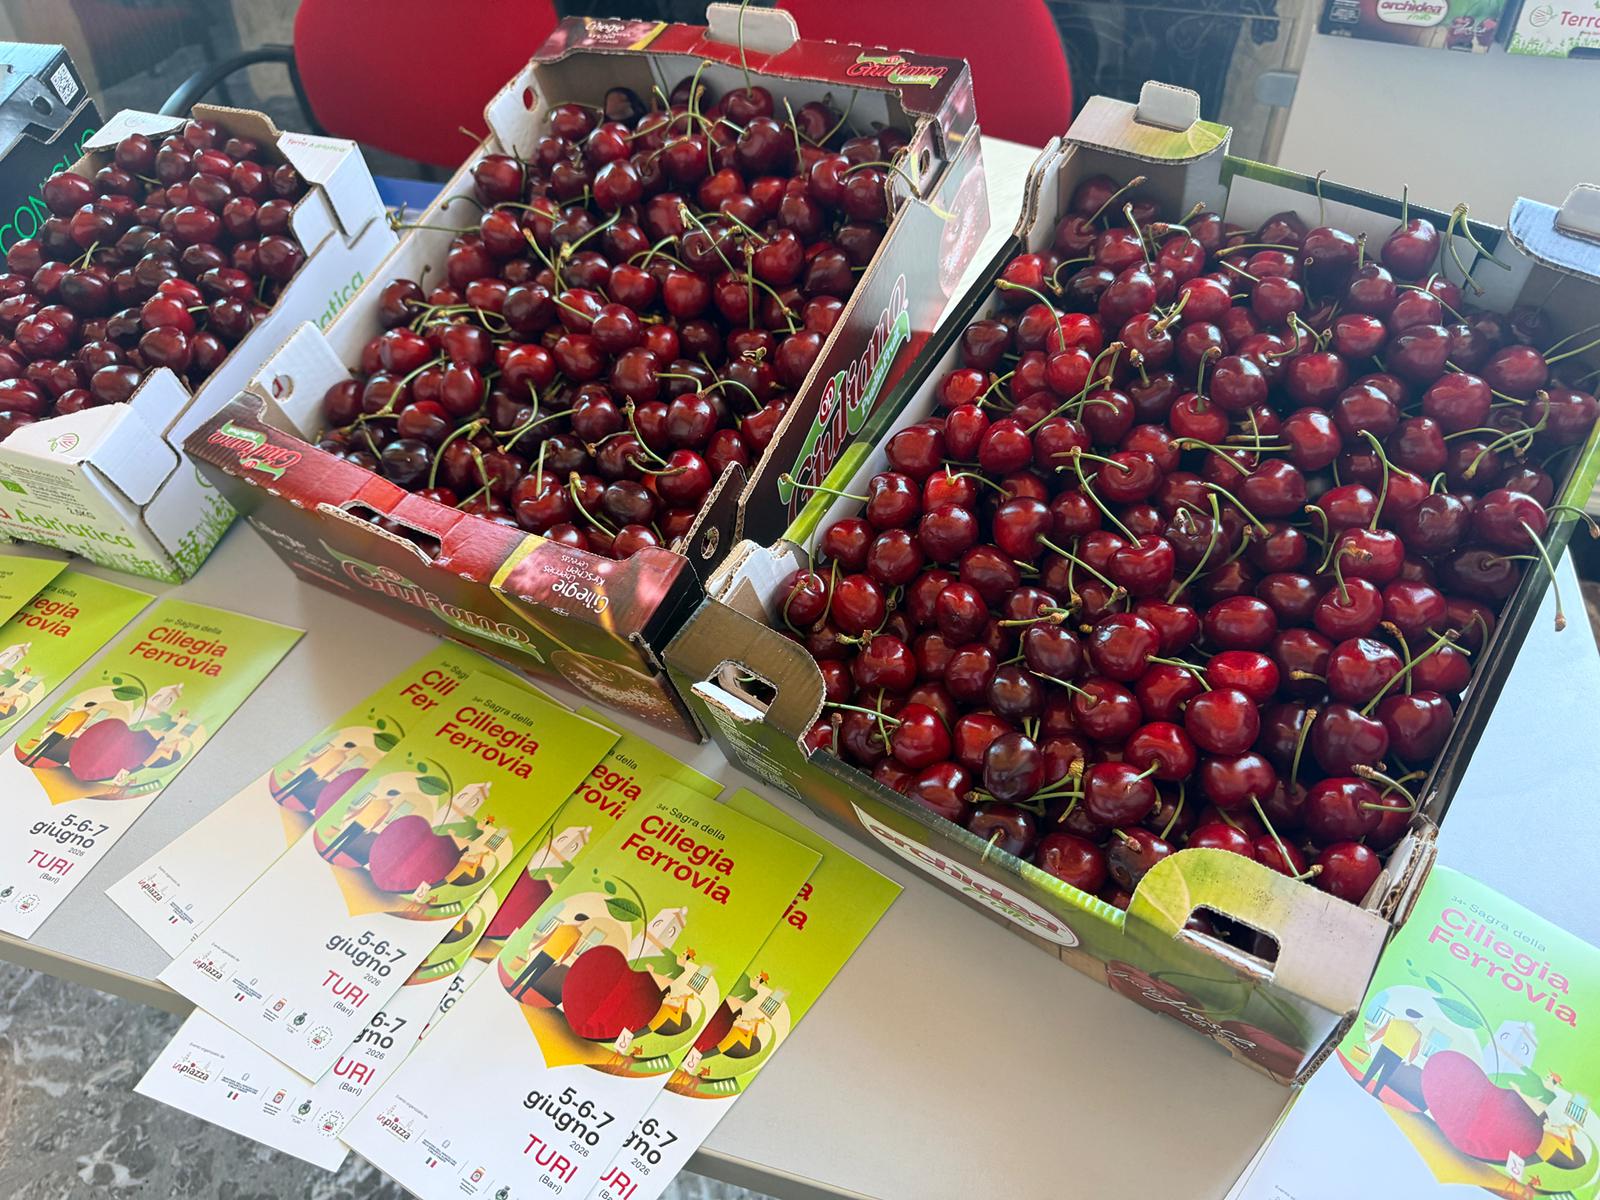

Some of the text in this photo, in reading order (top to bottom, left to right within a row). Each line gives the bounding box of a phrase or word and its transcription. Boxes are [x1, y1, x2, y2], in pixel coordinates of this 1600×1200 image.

[1381, 0, 1442, 14] orchidea
[312, 271, 365, 331] atica
[15, 508, 136, 549] Adriatica
[552, 579, 609, 613] Ciliegie
[128, 640, 223, 677] Ferrovia
[147, 626, 228, 658] Ciliegia
[421, 670, 460, 697] Cili
[483, 698, 511, 719] Sagra
[510, 708, 534, 727] della
[455, 705, 540, 756] Ciliegia
[435, 721, 534, 780] Ferrovia
[615, 752, 638, 771] della
[591, 763, 642, 801] egia
[30, 821, 95, 848] giugno
[61, 813, 109, 837] 5-6-7
[669, 806, 700, 830] Sagra
[700, 821, 727, 841] della
[640, 814, 735, 876] Ciliegia
[27, 849, 74, 876] TURI
[40, 872, 60, 884] (Bari)
[620, 832, 731, 905] Ferrovia
[1469, 903, 1511, 934] Sagra
[1513, 928, 1548, 953] della
[326, 935, 391, 977] giugno
[358, 930, 407, 964] 5-6-7
[1441, 907, 1570, 995] Ciliegia
[322, 969, 369, 1008] TURI
[363, 973, 382, 987] 2026
[1428, 925, 1578, 1028] Ferrovia
[333, 1001, 354, 1017] (Bari)
[371, 1011, 407, 1034] 6-7
[333, 1056, 375, 1086] URI
[365, 1048, 385, 1060] 2026
[338, 1081, 362, 1097] (Bari)
[523, 1090, 599, 1146] giugno
[558, 1086, 616, 1130] 5-6-7
[523, 1133, 578, 1184] TURI
[569, 1140, 590, 1158] 2026
[600, 1166, 638, 1200] URI
[631, 1157, 651, 1176] 2026
[538, 1173, 563, 1195] (Bari)
